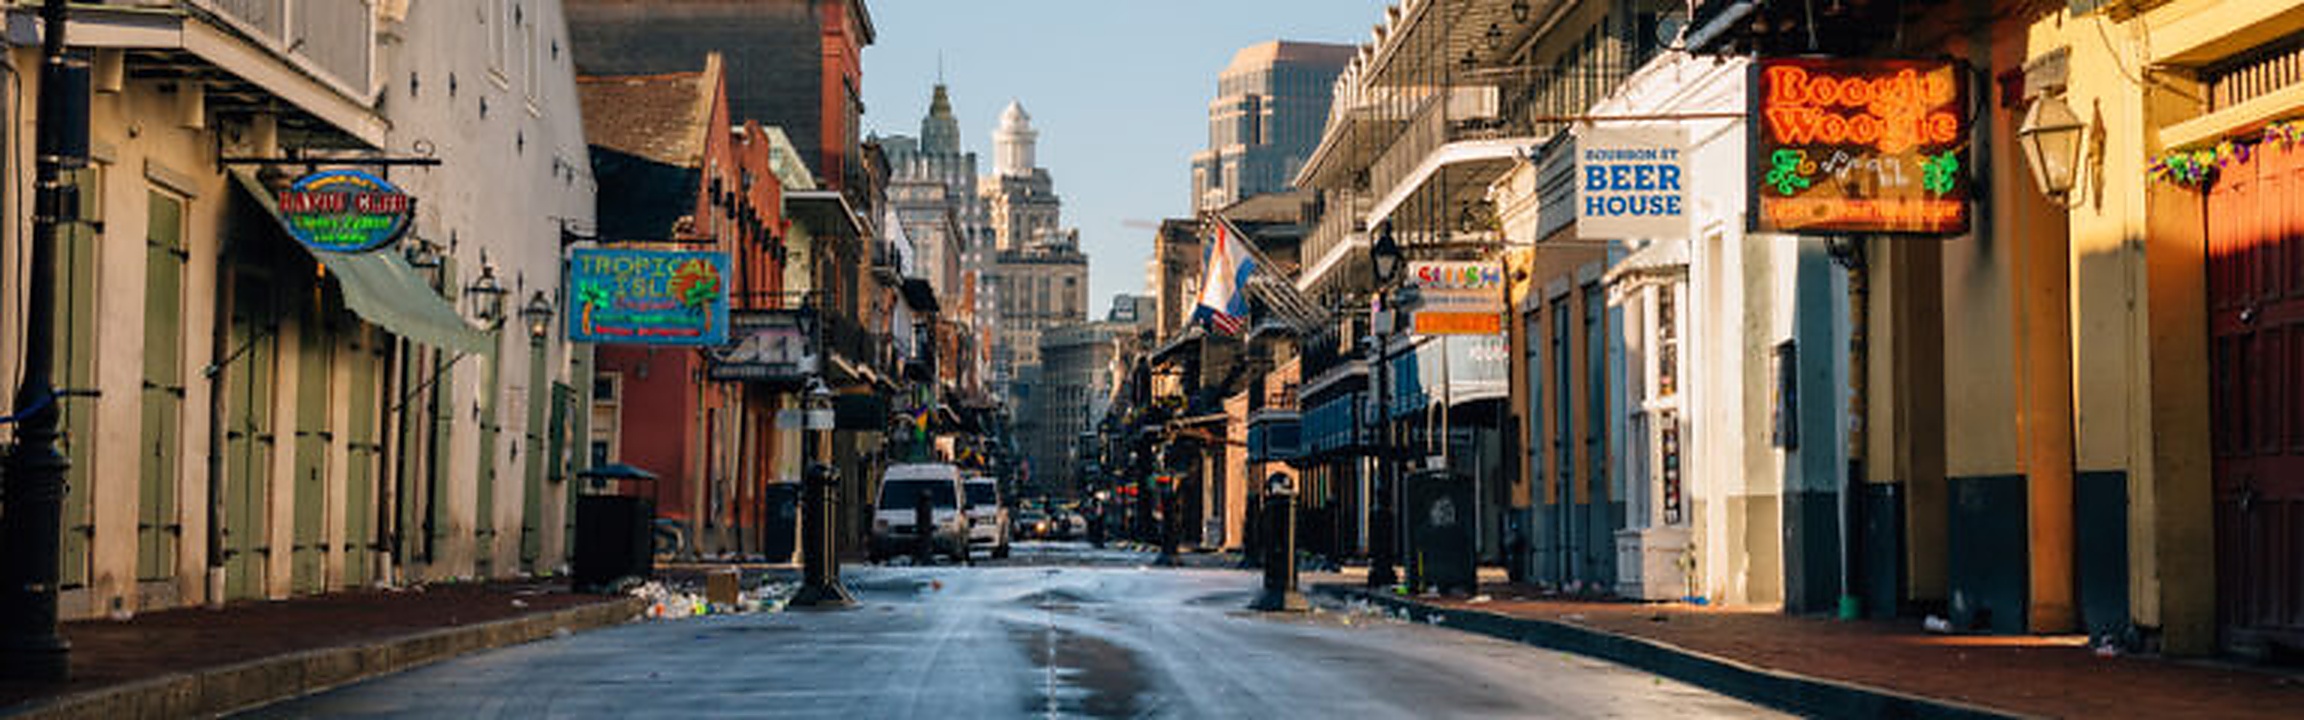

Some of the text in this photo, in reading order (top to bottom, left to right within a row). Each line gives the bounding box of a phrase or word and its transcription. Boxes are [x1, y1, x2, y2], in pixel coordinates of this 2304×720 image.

[1767, 66, 1951, 117] Boogie
[1766, 107, 1957, 153] Woogie
[1584, 149, 1679, 160] BOURBON ST
[1584, 164, 1680, 190] BEER
[1585, 195, 1681, 216] HOUSE
[579, 255, 711, 278] TROPICAL
[614, 274, 684, 298] ISLE
